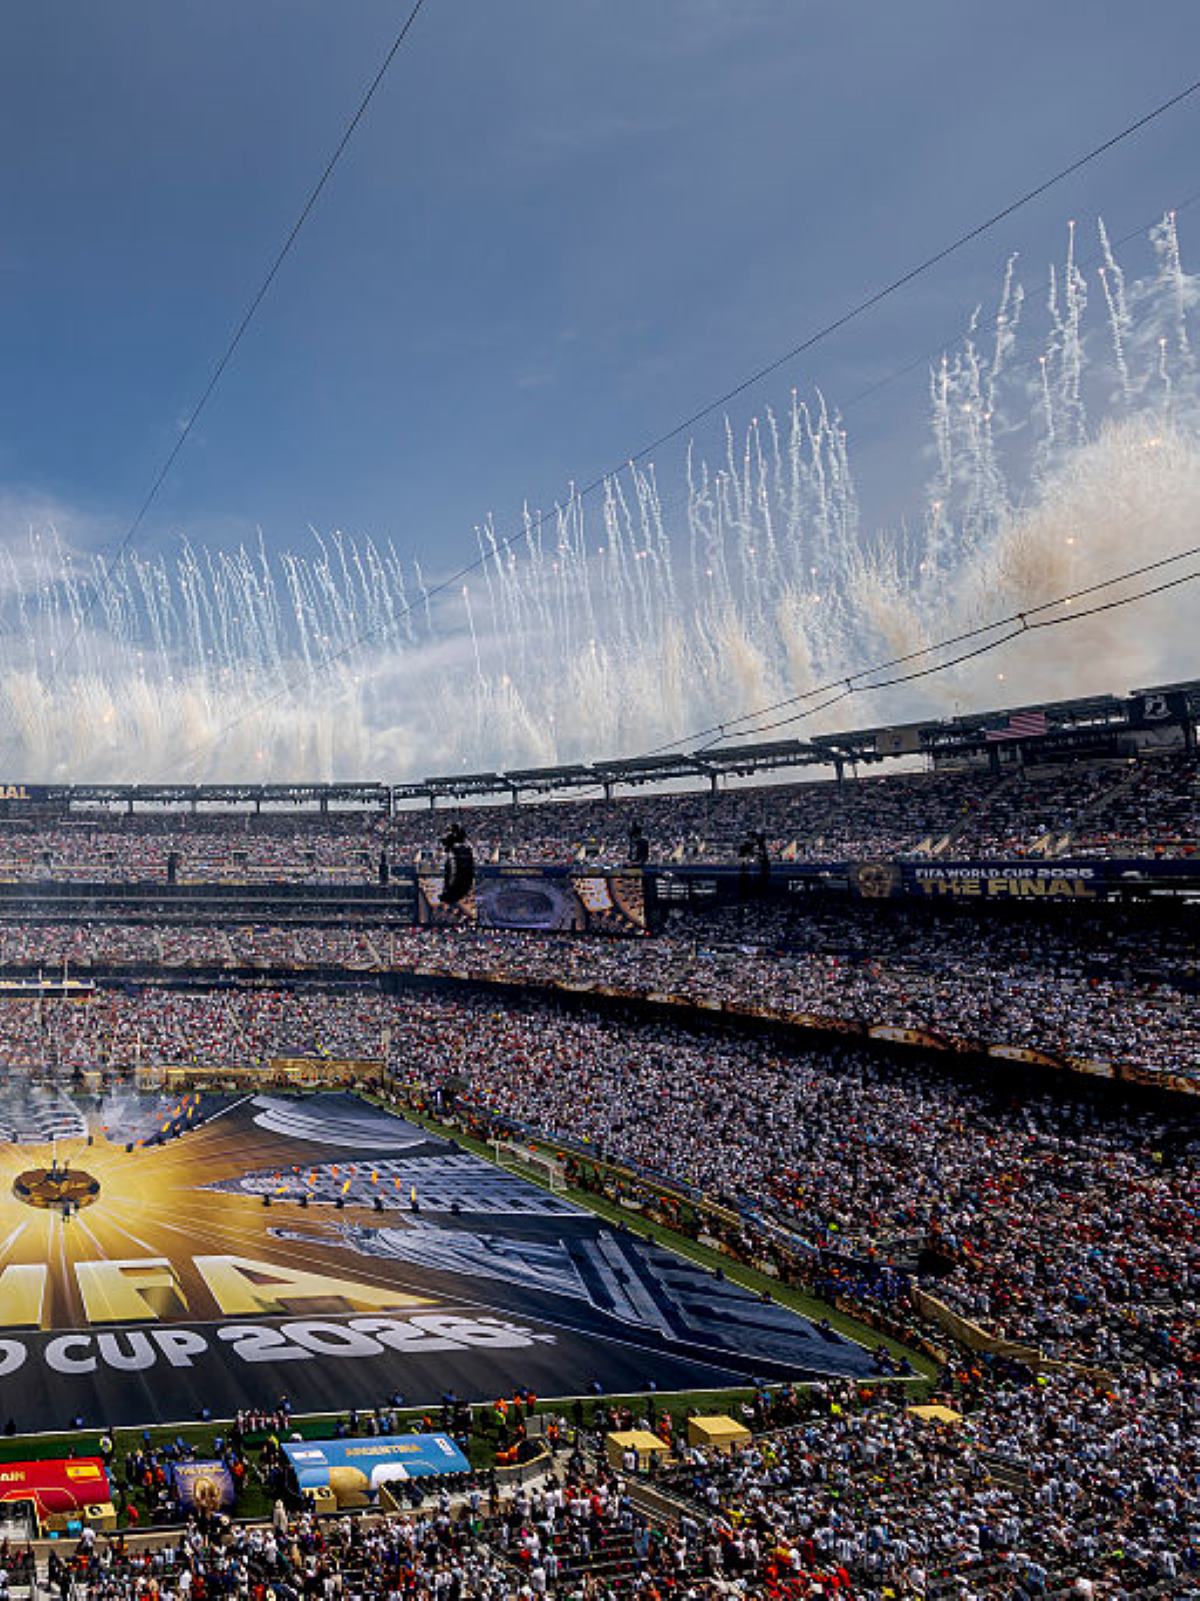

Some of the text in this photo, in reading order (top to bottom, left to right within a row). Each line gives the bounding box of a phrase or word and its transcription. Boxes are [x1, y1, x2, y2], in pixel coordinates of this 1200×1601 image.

[915, 868, 1095, 879] FIFA WORLD CUP 2026
[917, 878, 1097, 896] THE FINAL
[44, 1330, 208, 1373] CUP
